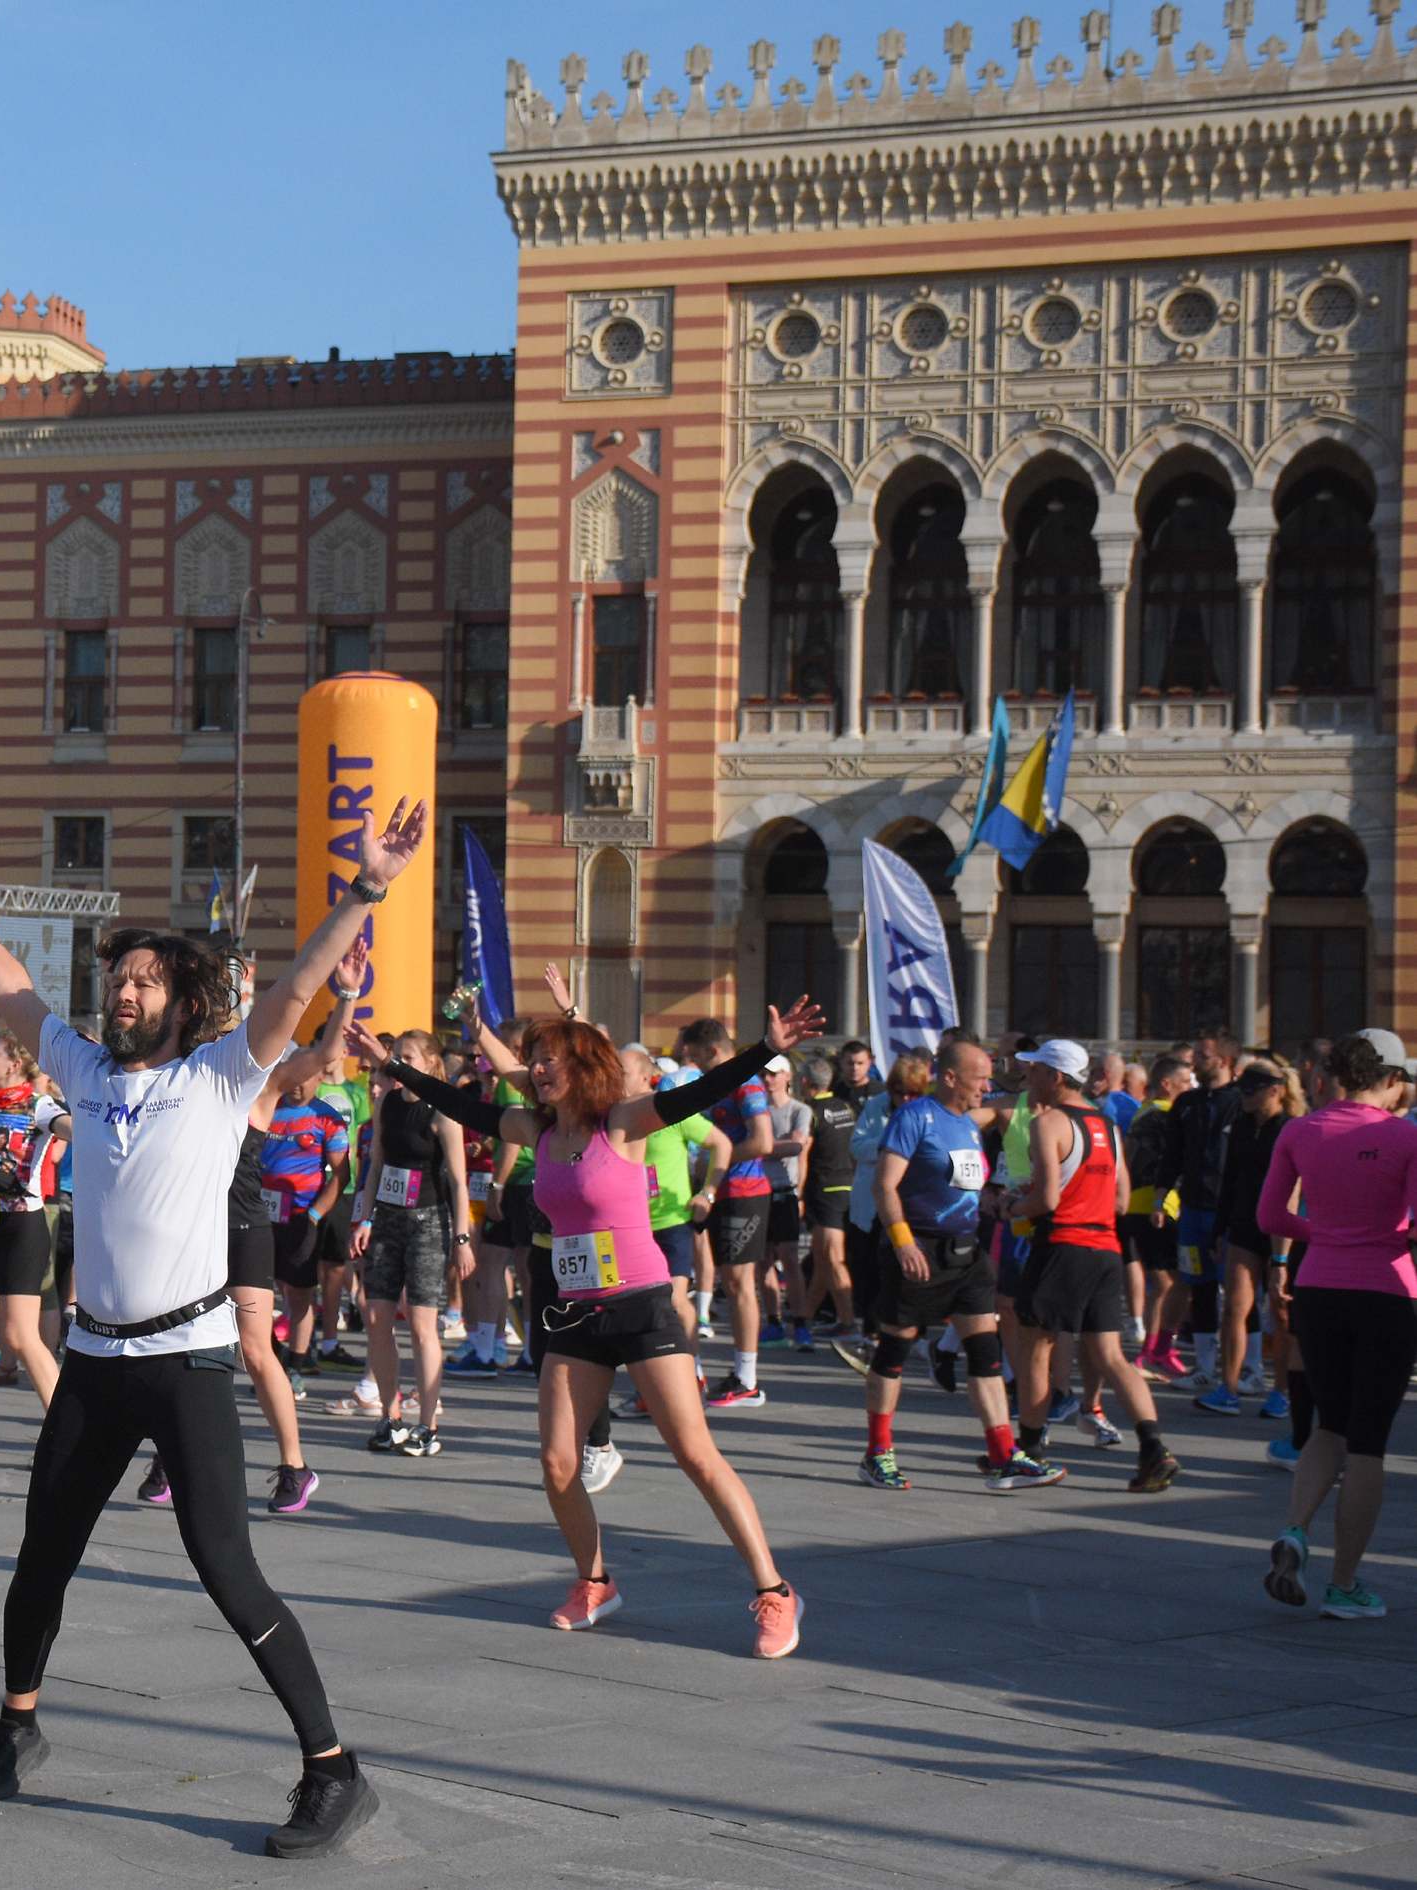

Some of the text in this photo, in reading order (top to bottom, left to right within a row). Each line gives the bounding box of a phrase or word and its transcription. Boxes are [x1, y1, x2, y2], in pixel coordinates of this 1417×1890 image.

[145, 1097, 185, 1108] SARAJEVSKI
[145, 1104, 180, 1114] MARATON
[960, 1163, 981, 1177] 1571
[383, 1178, 405, 1194] 1601
[558, 1254, 587, 1275] 857
[606, 1274, 613, 1283] 5
